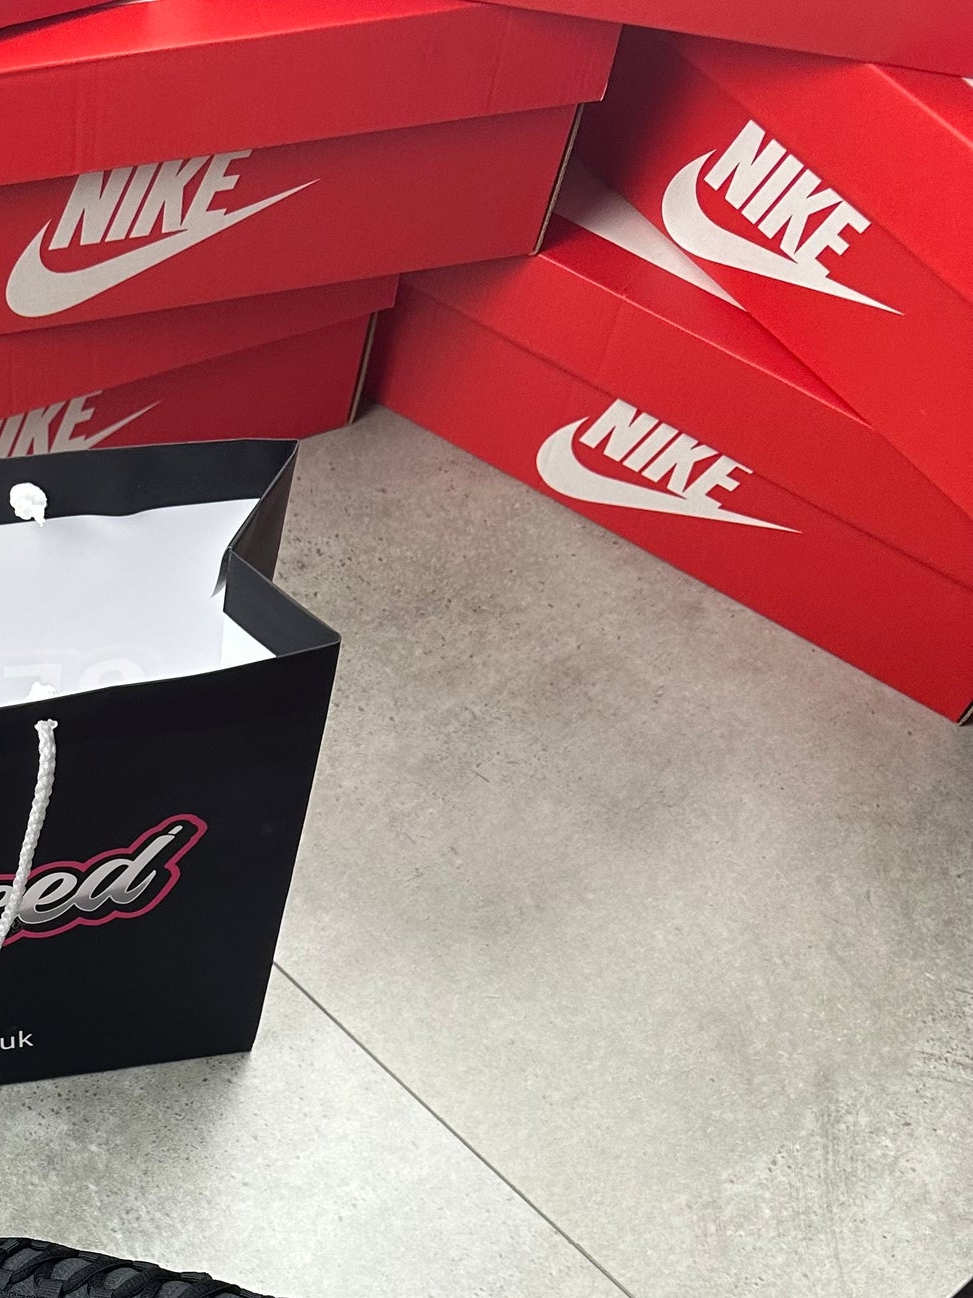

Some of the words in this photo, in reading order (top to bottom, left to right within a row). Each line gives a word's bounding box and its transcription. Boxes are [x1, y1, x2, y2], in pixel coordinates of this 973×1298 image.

[48, 149, 252, 250] NIKE
[704, 119, 872, 278] NIKE
[578, 398, 754, 509] NIKE
